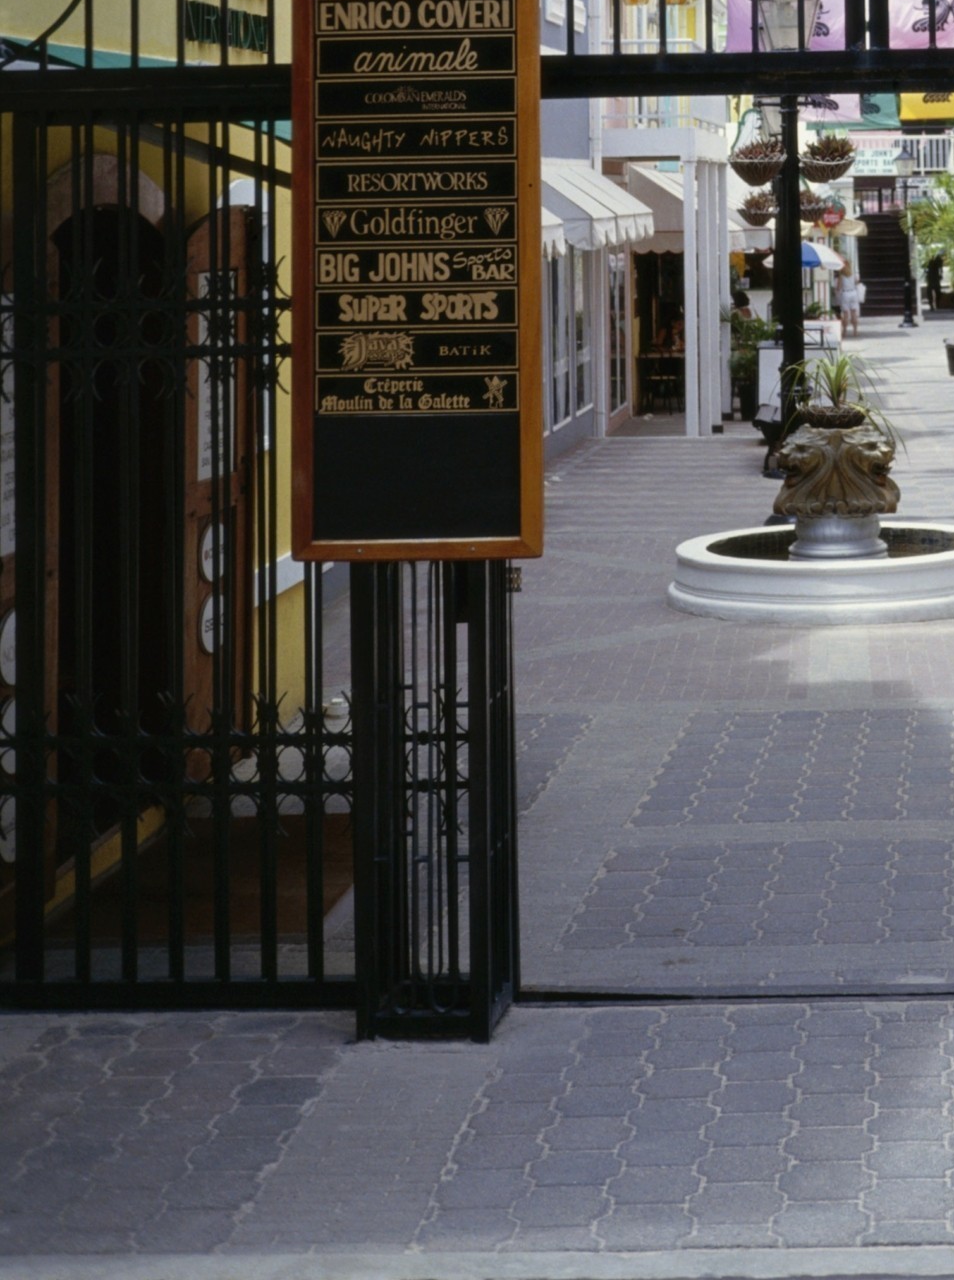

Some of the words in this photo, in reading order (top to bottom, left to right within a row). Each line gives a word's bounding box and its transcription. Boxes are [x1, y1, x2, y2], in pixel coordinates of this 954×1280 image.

[320, 1, 411, 31] ENRICO
[418, 0, 510, 29] COVERI
[353, 38, 479, 72] animale
[348, 171, 488, 193] RESORTWORKS
[350, 208, 478, 240] Goldfinger
[320, 253, 360, 283] BIG
[369, 252, 451, 282] JOHNS
[453, 248, 512, 270] Sports
[471, 263, 515, 281] BAR
[338, 293, 408, 322] SUPER
[420, 291, 499, 321] SPORTS
[320, 394, 373, 412] Moulin
[378, 394, 394, 410] de
[399, 394, 413, 409] la
[418, 392, 471, 410] Galette
